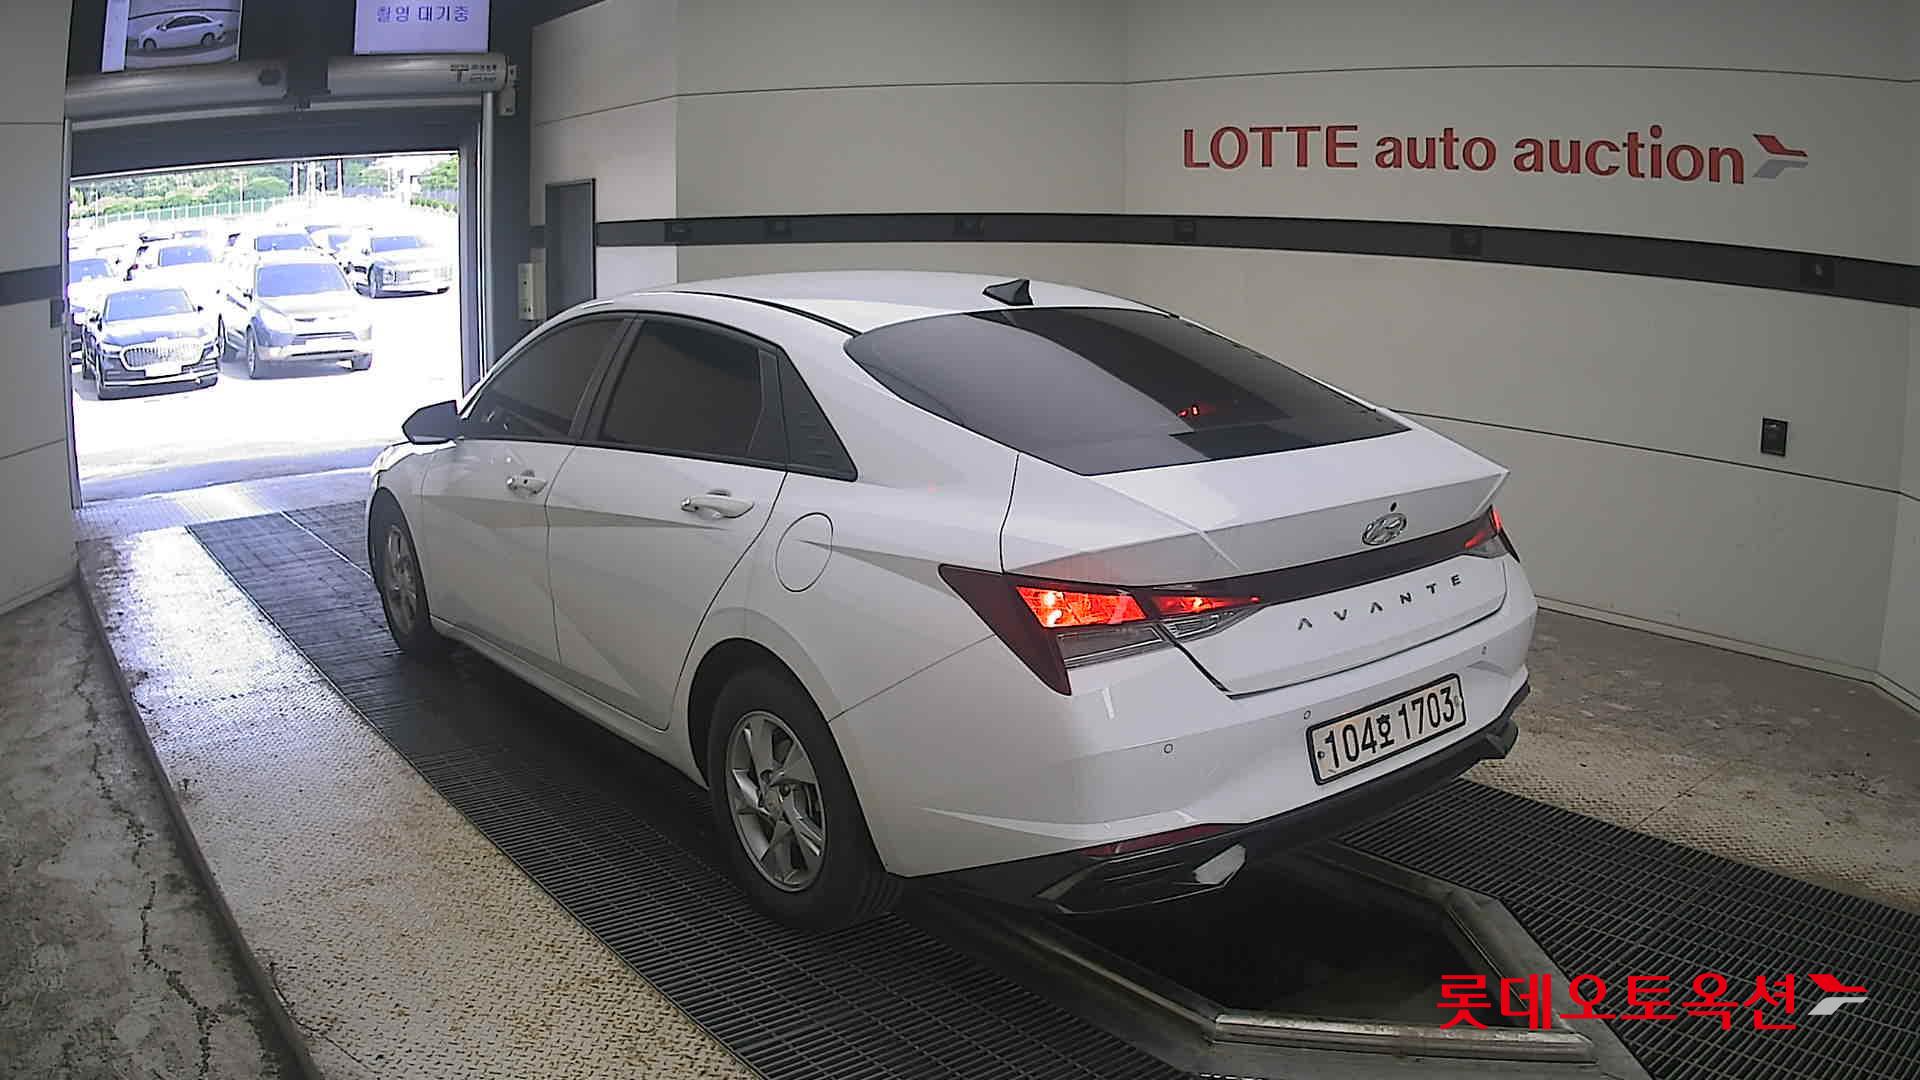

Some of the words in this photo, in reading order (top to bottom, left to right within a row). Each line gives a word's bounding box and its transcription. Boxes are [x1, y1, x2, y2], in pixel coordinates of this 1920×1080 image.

[418, 5, 468, 22] 대기중
[1183, 124, 1358, 169] LOTTE
[1374, 127, 1496, 171] auto
[1513, 124, 1745, 184] auction
[1297, 574, 1462, 631] AVANTE
[1398, 686, 1455, 740] 1703
